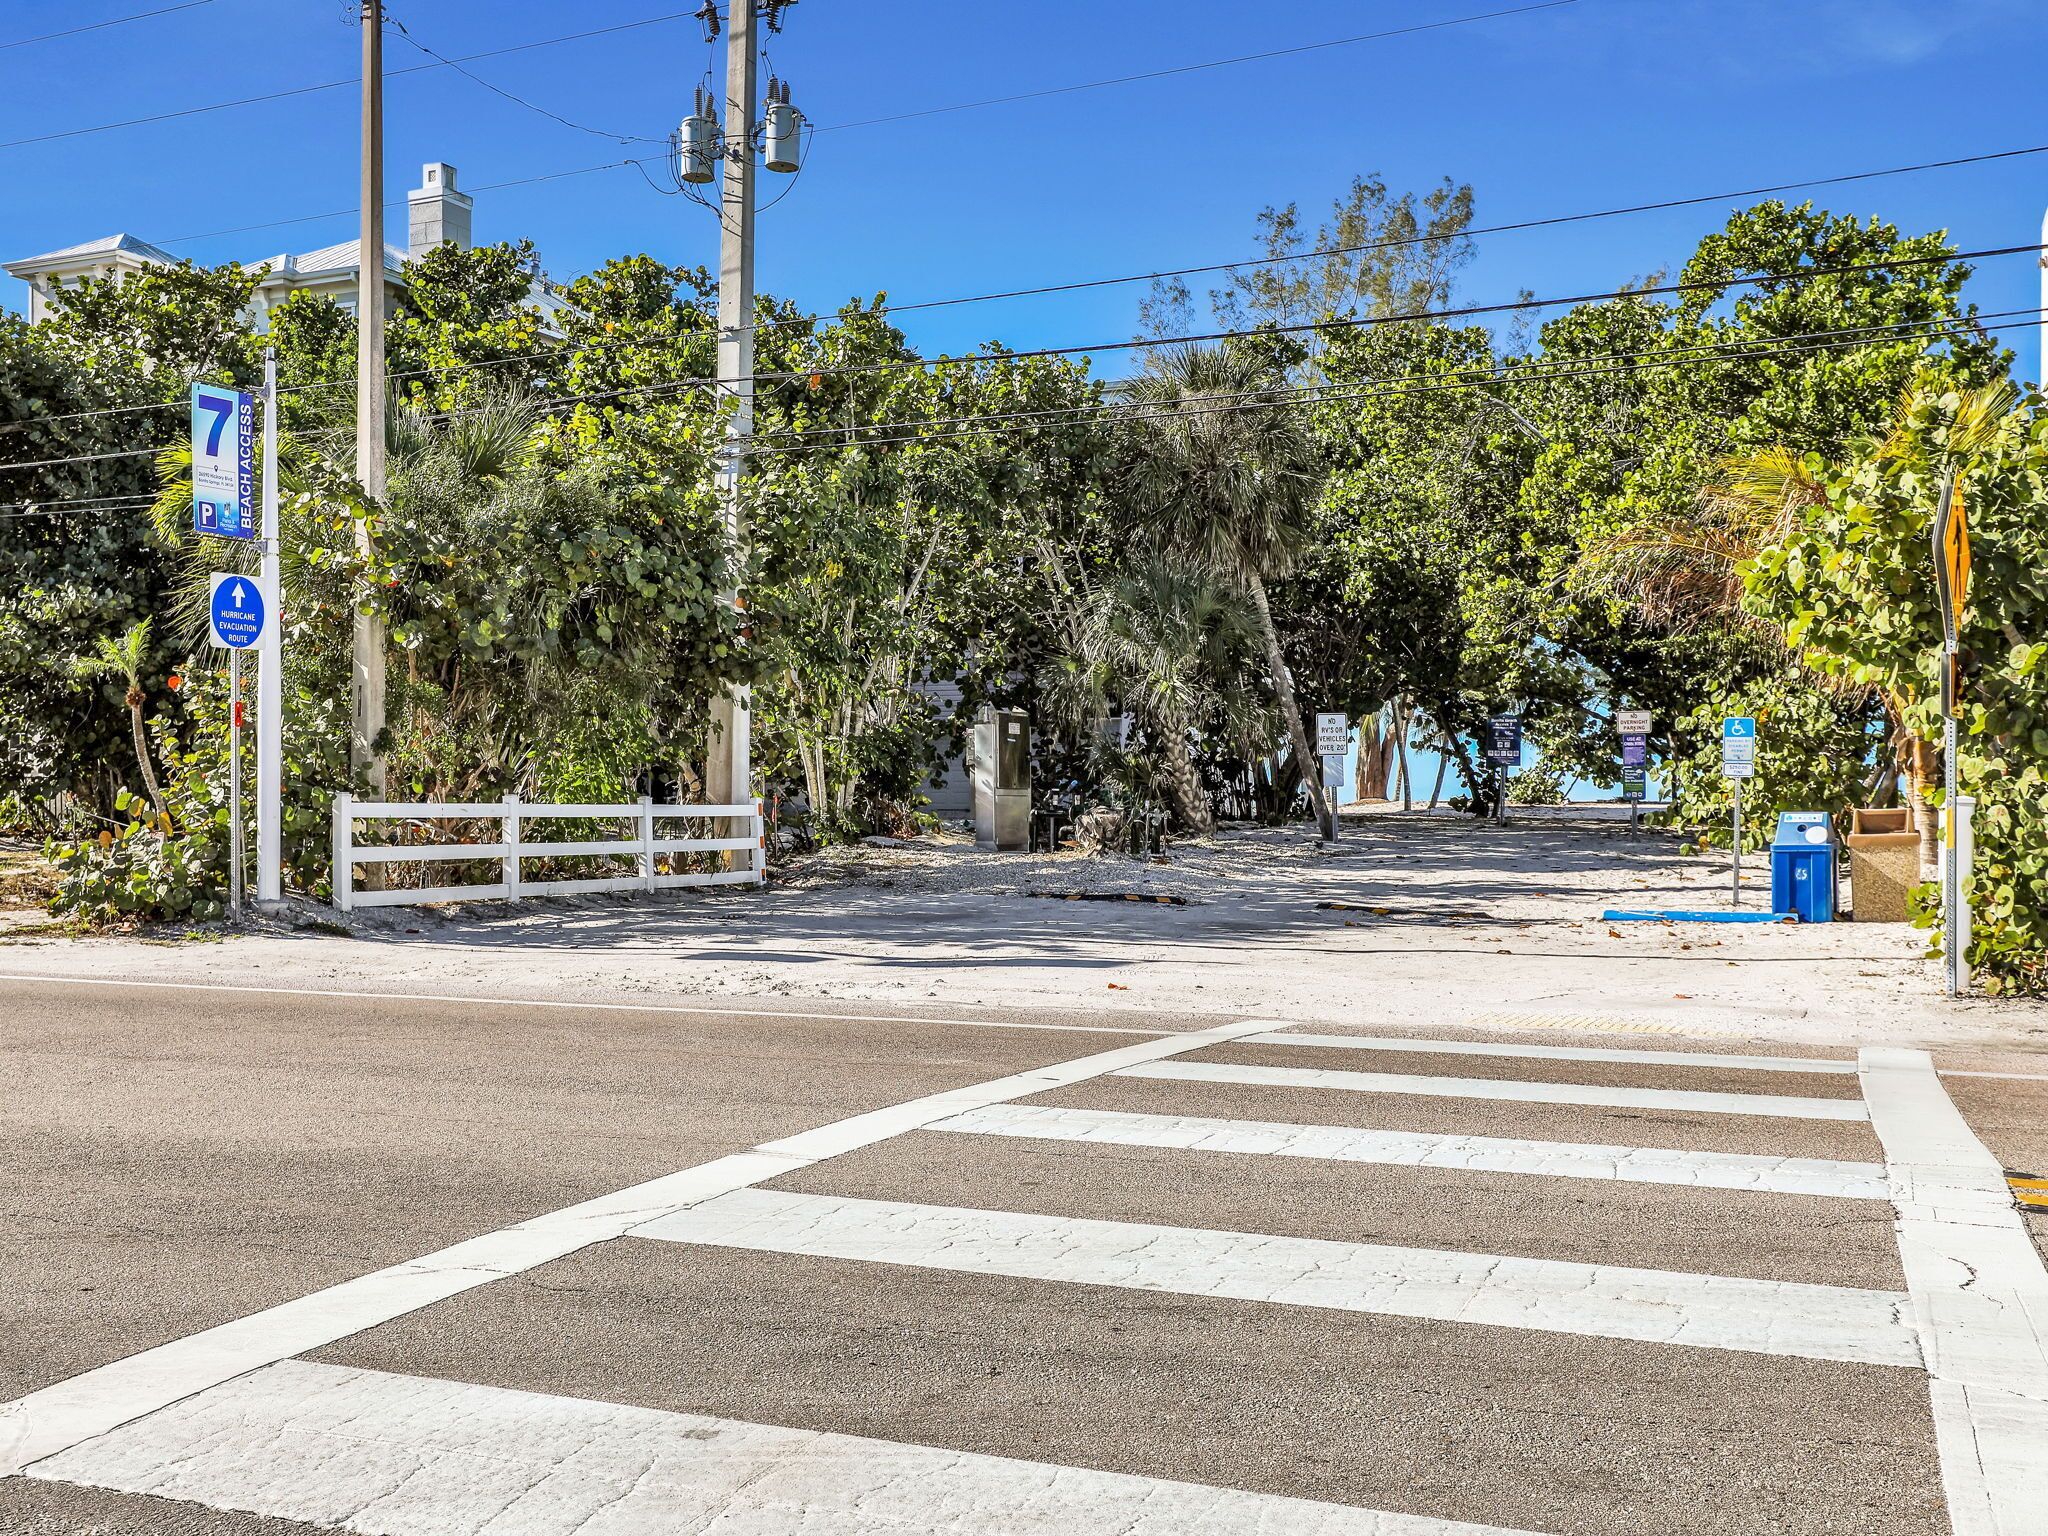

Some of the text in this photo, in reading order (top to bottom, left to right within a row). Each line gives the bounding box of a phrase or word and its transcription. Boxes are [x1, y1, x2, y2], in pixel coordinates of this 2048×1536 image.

[199, 393, 233, 457] 7
[240, 404, 252, 528] BEACH ACCESS
[201, 503, 213, 525] P
[221, 610, 255, 621] HURRICANE
[219, 621, 257, 632] EVACUATION
[228, 634, 248, 643] ROUTE
